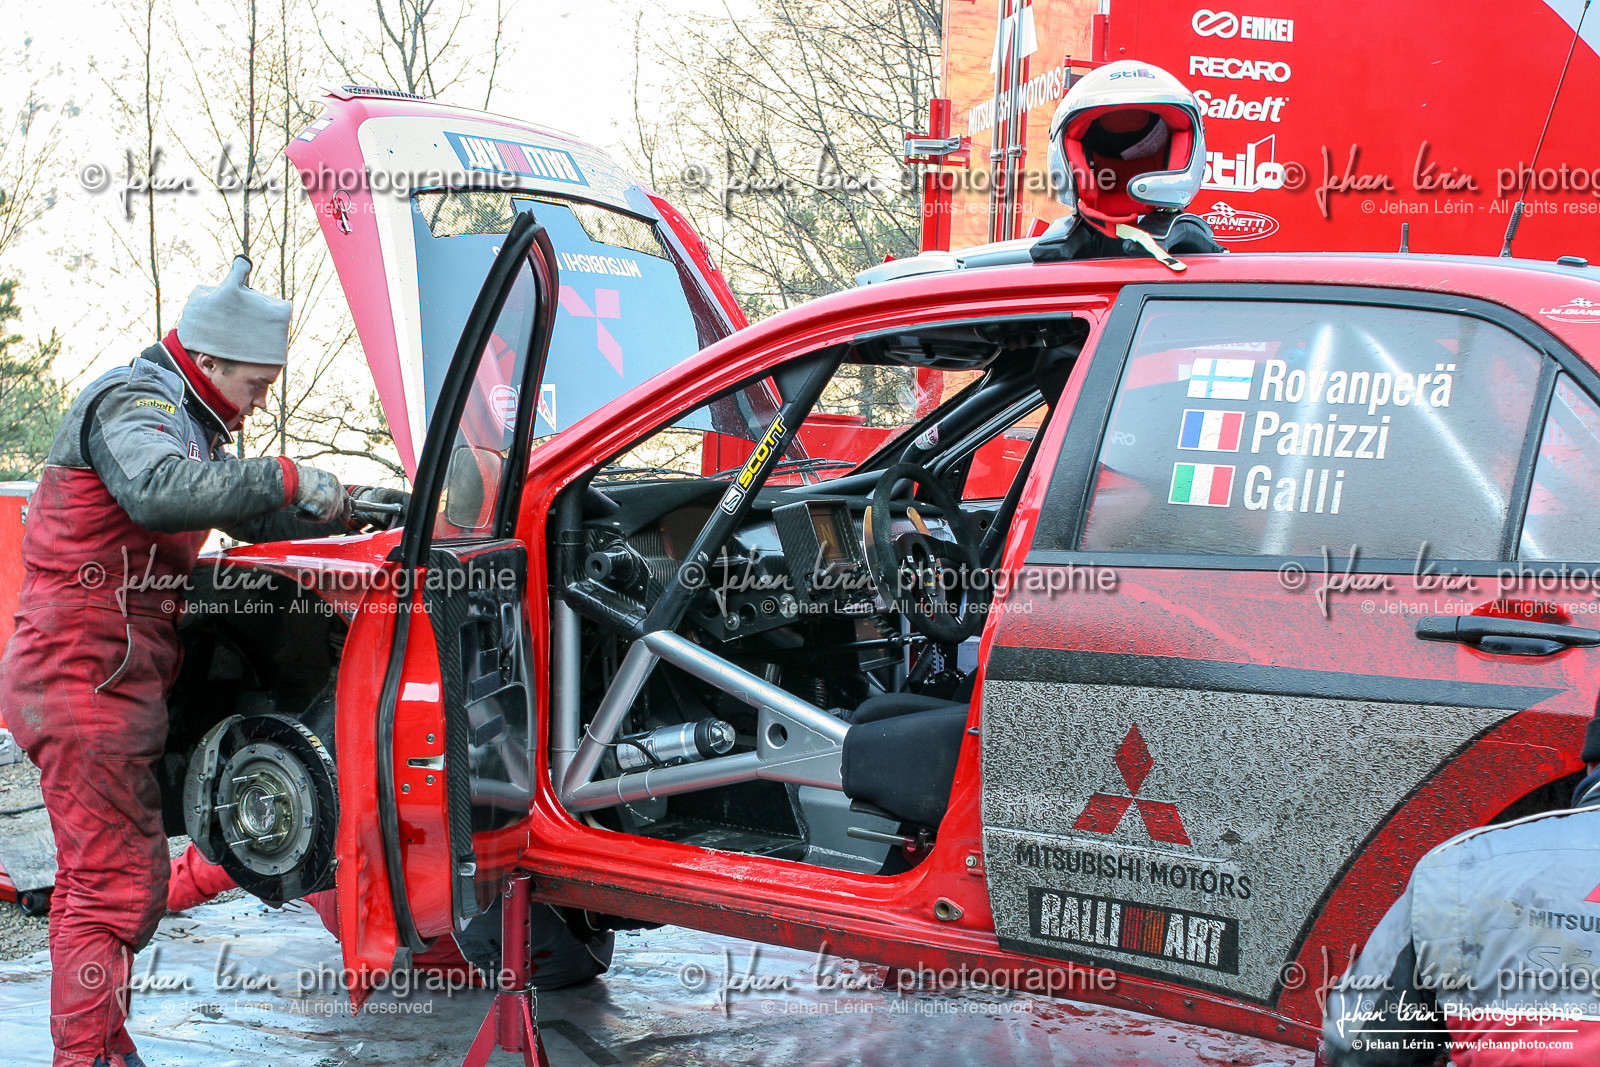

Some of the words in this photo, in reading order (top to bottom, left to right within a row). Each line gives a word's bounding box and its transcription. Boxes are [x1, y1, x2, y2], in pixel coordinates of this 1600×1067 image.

[1241, 15, 1294, 42] ENKEI
[1017, 66, 1062, 116] MOTORS
[1189, 55, 1292, 83] RECARO
[1193, 89, 1286, 122] Sabelt
[519, 145, 581, 182] RALLI
[1209, 225, 1264, 233] ALPARTS
[561, 252, 643, 279] MITSUBISHI
[1259, 359, 1456, 416] Rovanperä
[738, 416, 784, 489] SCOTT
[1250, 410, 1391, 460] Panizzi
[1243, 464, 1345, 515] Galli
[1016, 844, 1142, 883] MITSUBISHI
[1150, 864, 1251, 900] MOTORS
[1040, 893, 1122, 949] RALLI
[1163, 913, 1227, 967] ART
